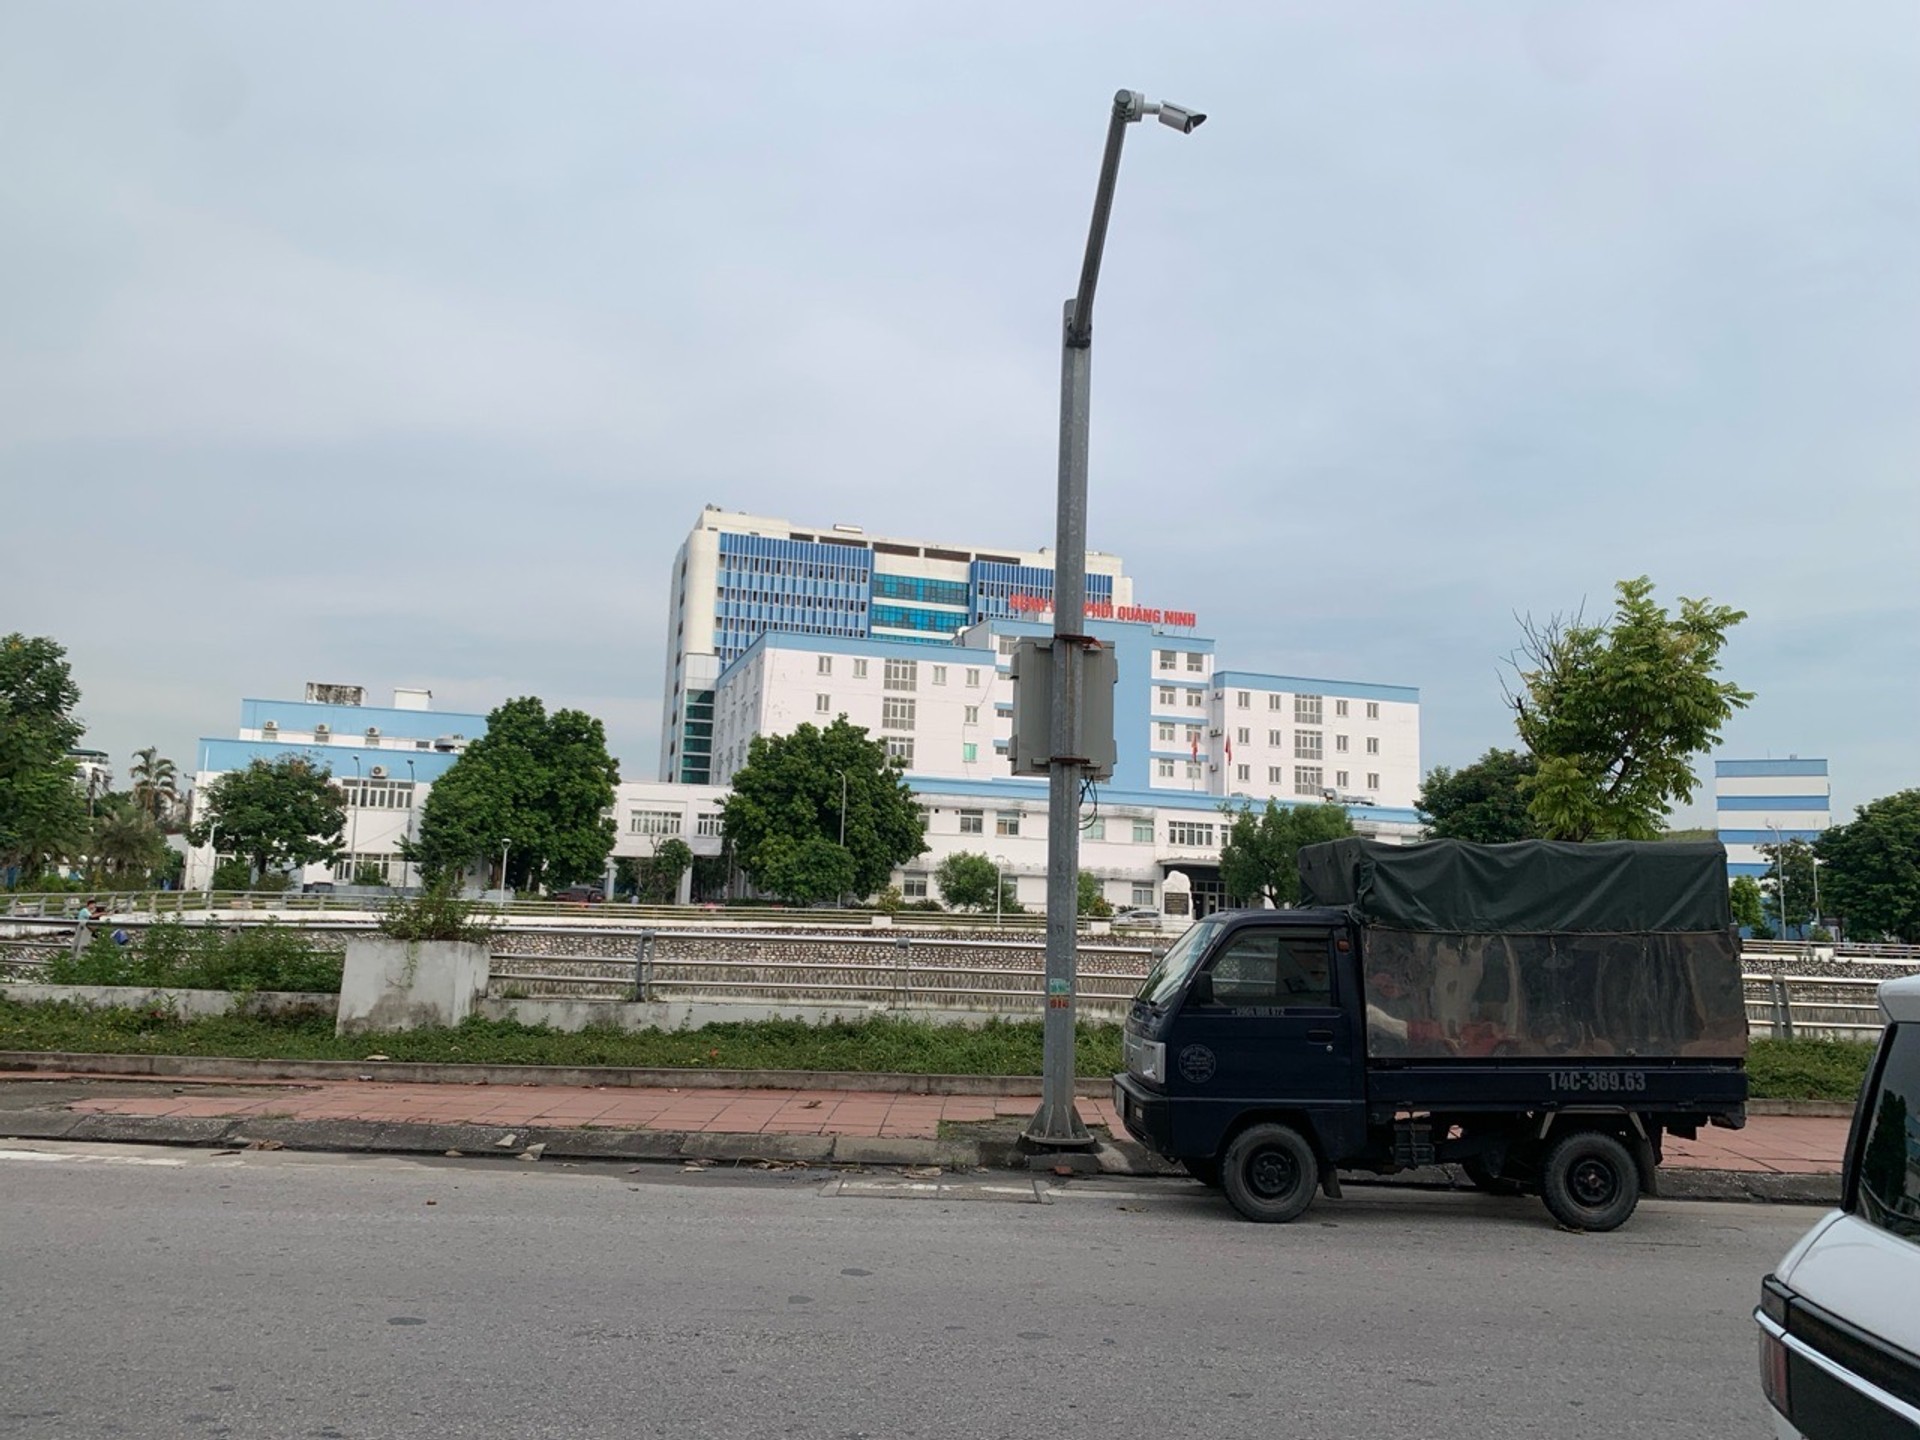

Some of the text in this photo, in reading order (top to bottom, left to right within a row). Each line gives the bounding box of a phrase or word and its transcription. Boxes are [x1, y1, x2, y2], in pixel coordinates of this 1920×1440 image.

[1117, 603, 1161, 624] QUẢNG
[1164, 610, 1196, 628] NINH
[1548, 1070, 1646, 1091] 14C-369.63
